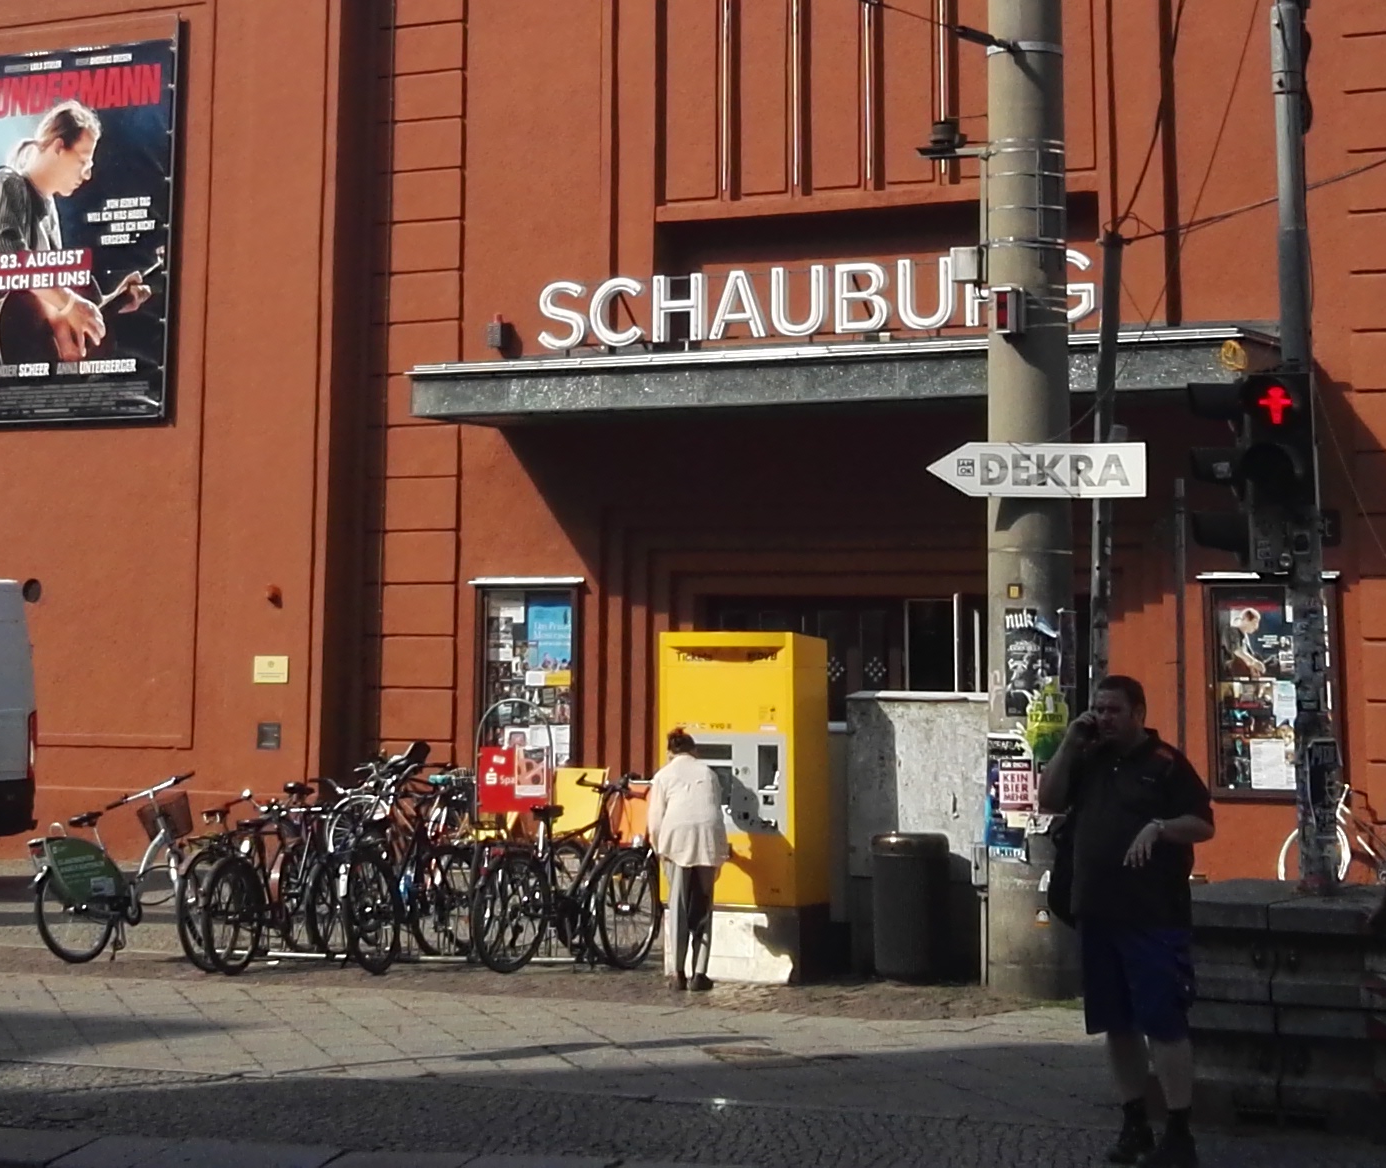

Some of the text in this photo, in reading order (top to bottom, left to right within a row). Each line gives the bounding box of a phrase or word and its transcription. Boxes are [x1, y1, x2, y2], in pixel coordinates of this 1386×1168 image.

[0, 254, 22, 269] 23.
[26, 249, 84, 267] AUGUST
[33, 274, 49, 288] BEI
[57, 270, 91, 286] UNS!
[538, 249, 1099, 350] SCHAUBUG
[979, 453, 1130, 487] DEKRA
[1003, 774, 1028, 783] KEIN
[1003, 783, 1028, 792] BIER
[1003, 793, 1029, 801] MEHR
